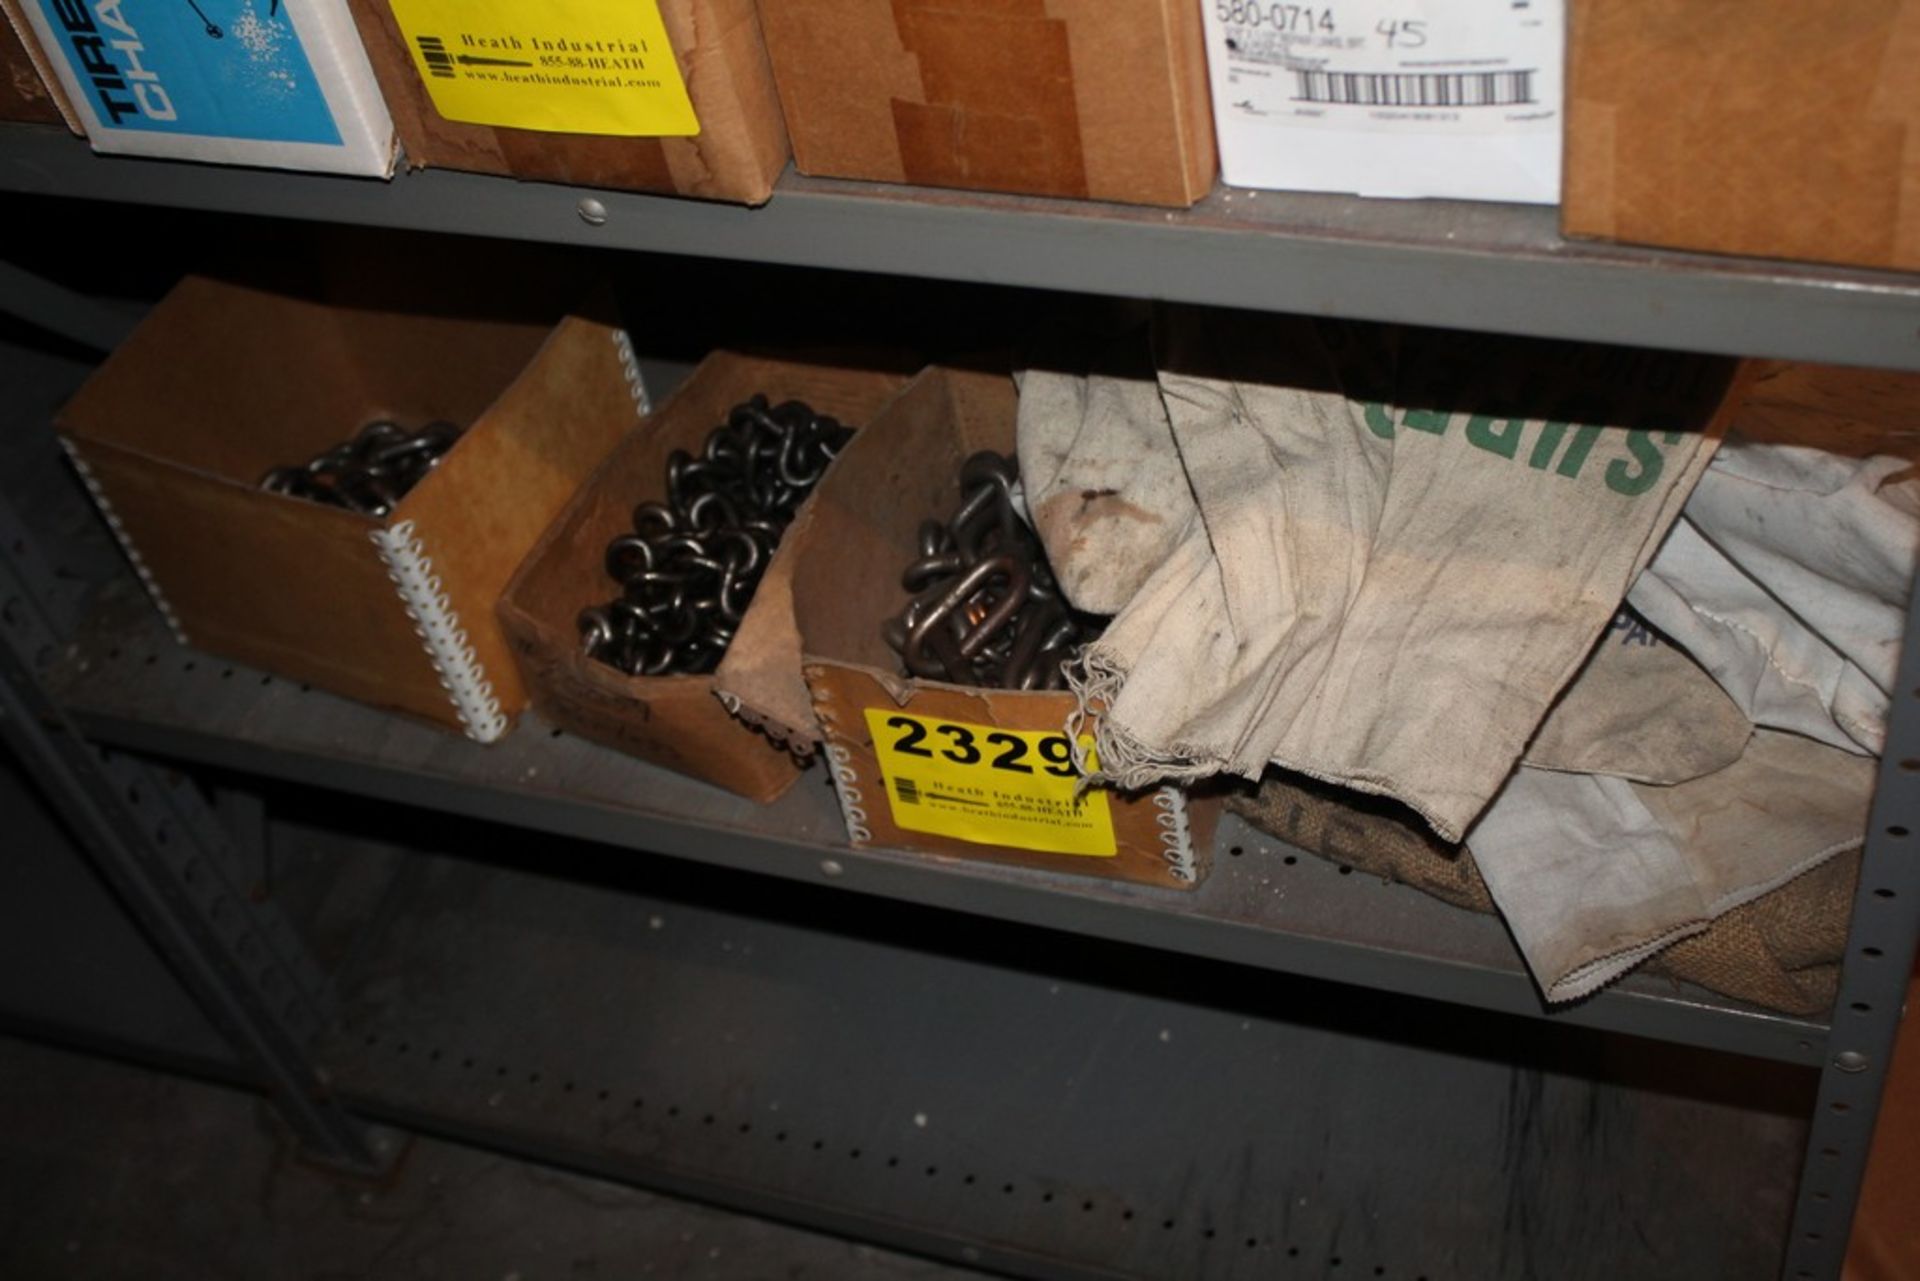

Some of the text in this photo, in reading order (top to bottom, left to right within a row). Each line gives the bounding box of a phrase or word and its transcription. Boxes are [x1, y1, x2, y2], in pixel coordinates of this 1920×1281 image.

[1217, 0, 1335, 33] 580-0714
[461, 34, 650, 54] Heath Industrial
[1376, 18, 1426, 48] 45
[51, 0, 138, 124] TIRE
[539, 55, 646, 72] 855-88-HEATH
[463, 72, 661, 89] www.heathindustrial.com
[887, 716, 1078, 778] 2329
[933, 781, 985, 797] Heath
